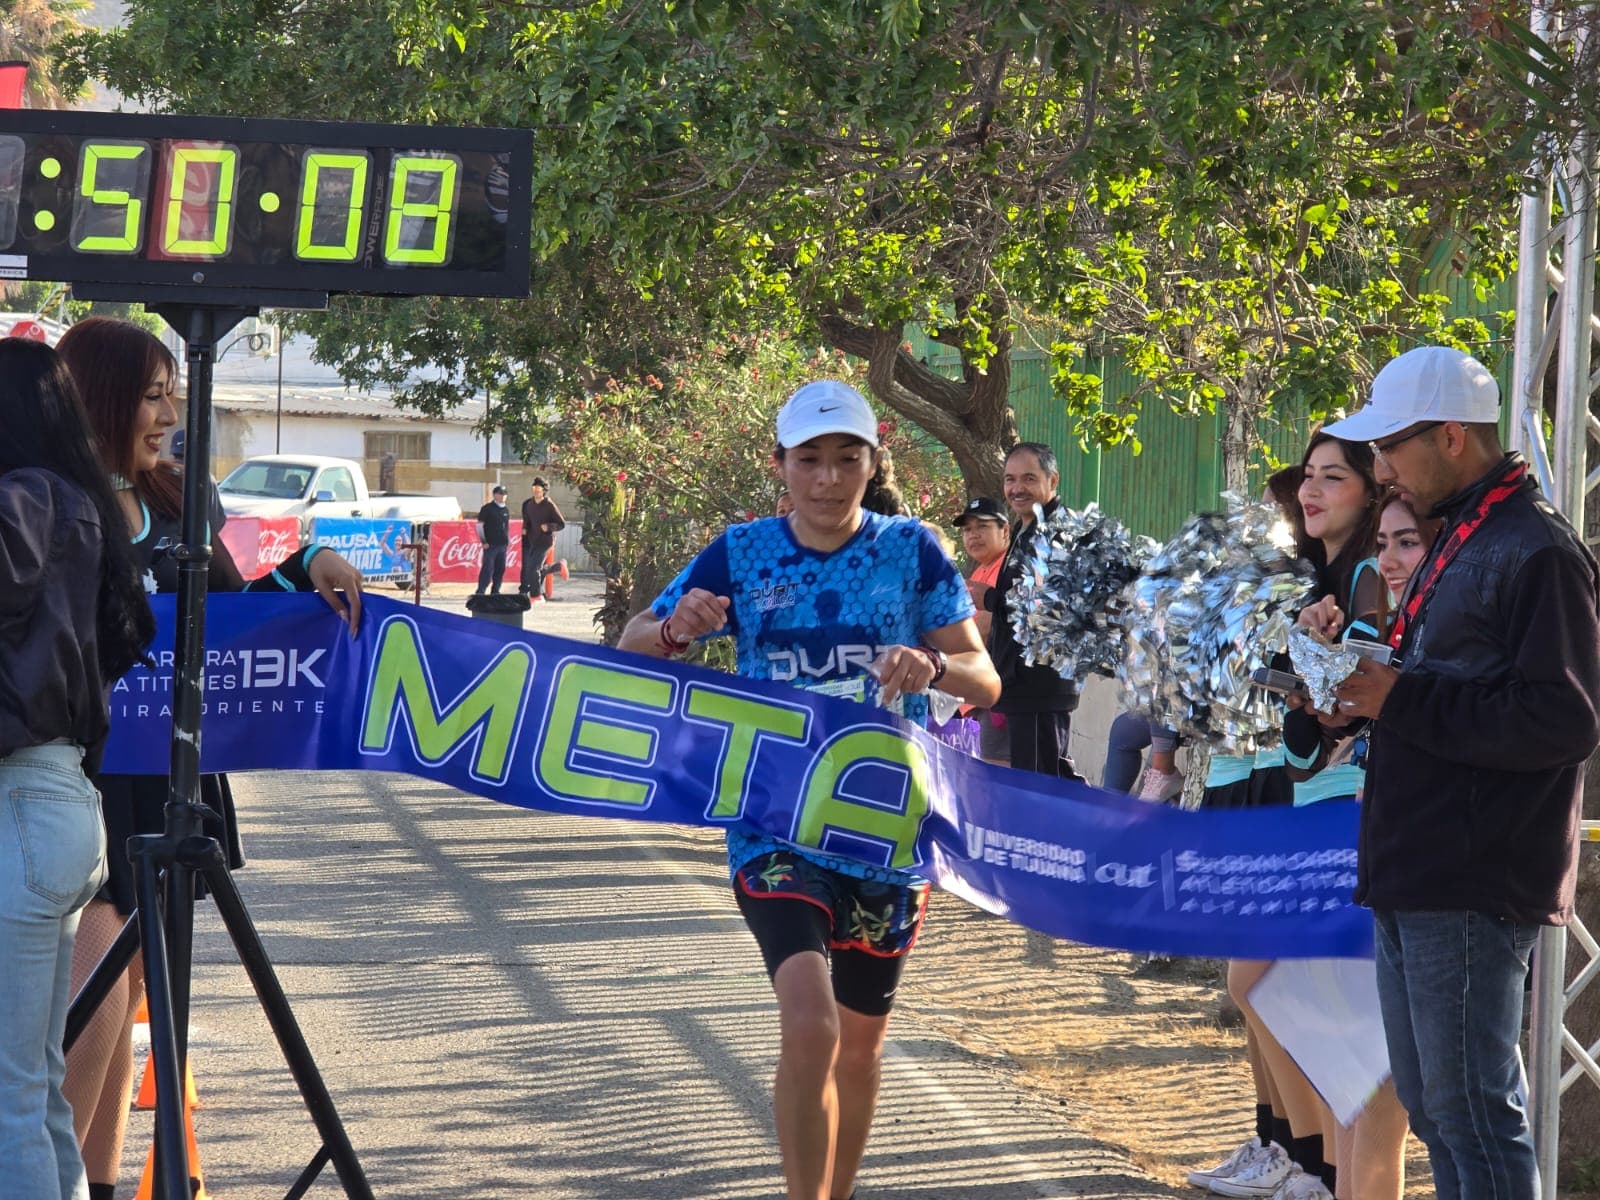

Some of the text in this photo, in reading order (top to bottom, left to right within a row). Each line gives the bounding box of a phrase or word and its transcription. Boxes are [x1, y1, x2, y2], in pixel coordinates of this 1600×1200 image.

[317, 532, 379, 549] PAUSA
[132, 648, 327, 689] ARRA 13K
[136, 674, 237, 692] TITES
[359, 613, 933, 869] META
[964, 821, 1087, 866] UNIVERSIDAD
[983, 847, 1008, 866] DE
